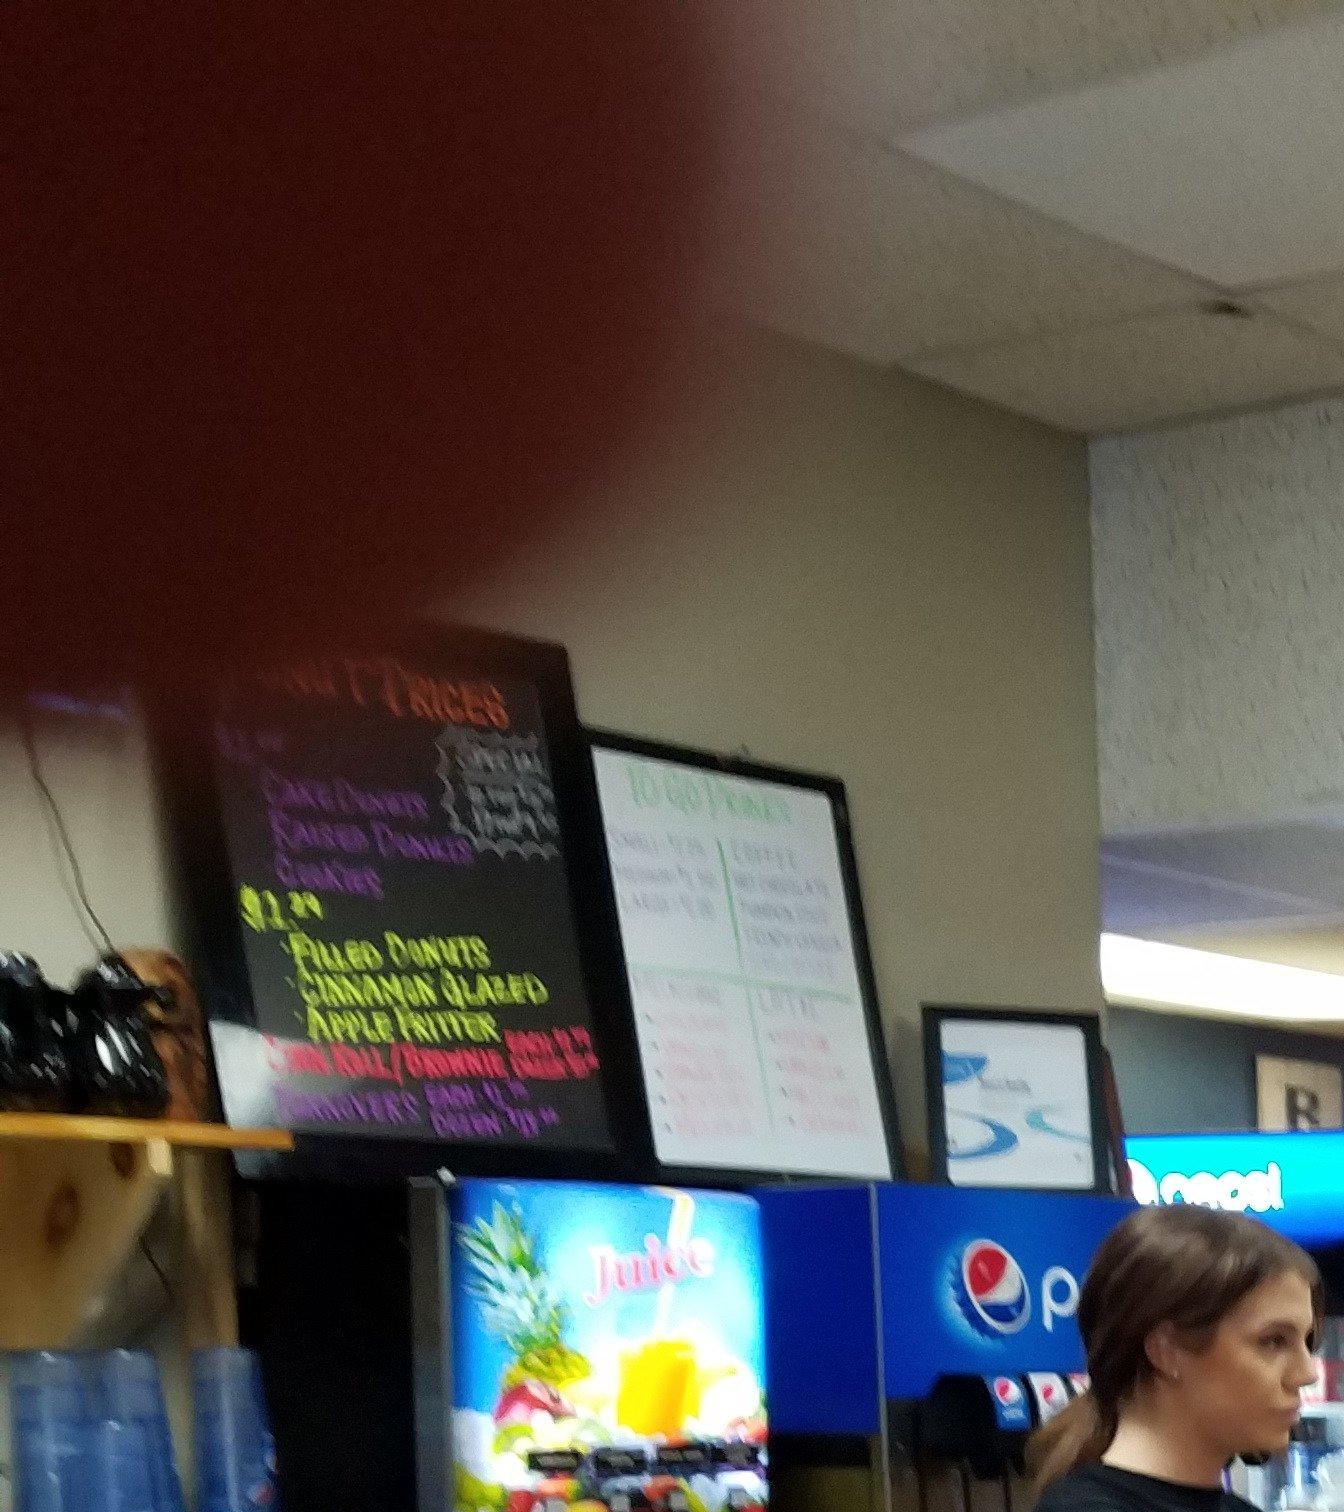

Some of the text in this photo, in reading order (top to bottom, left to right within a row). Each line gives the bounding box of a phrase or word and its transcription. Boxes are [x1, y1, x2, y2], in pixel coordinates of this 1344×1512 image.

[286, 930, 492, 970] FILLED DONUTS
[297, 964, 549, 1011] CINNAMON GLAZED
[305, 1004, 502, 1043] APPLE FRITTER
[582, 1233, 716, 1307] Juice
